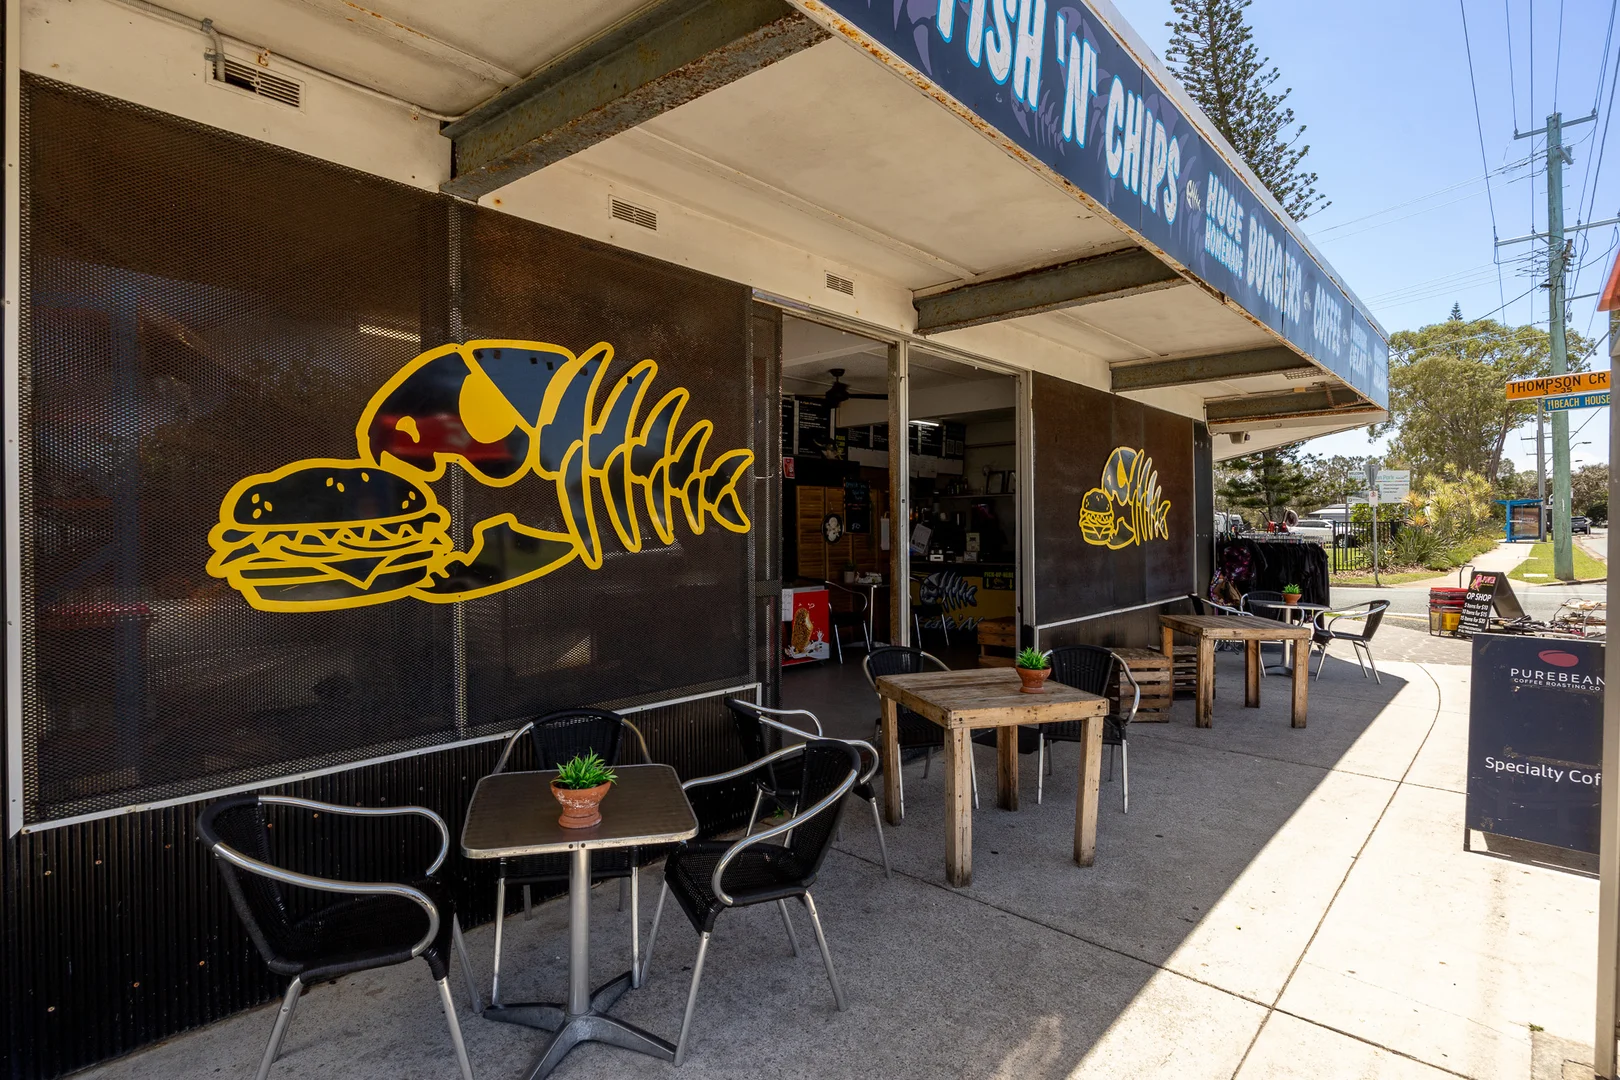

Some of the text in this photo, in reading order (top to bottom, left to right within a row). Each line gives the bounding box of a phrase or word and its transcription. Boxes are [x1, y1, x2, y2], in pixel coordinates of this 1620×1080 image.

[1105, 75, 1180, 225] CHIPS
[1206, 171, 1244, 245] HUGE
[1204, 217, 1244, 279] HOMEMADE
[1246, 214, 1302, 326] BURGERS
[1313, 283, 1342, 357] COFFEE
[1510, 372, 1606, 394] THOMPSON CR
[1554, 394, 1611, 409] BEACH HOUSE
[1466, 592, 1492, 602] OP SHOP
[1510, 668, 1605, 686] PUREBEAN
[1513, 677, 1543, 685] COFFEE
[1545, 681, 1586, 690] ROASTING
[1485, 756, 1564, 782] Specialty
